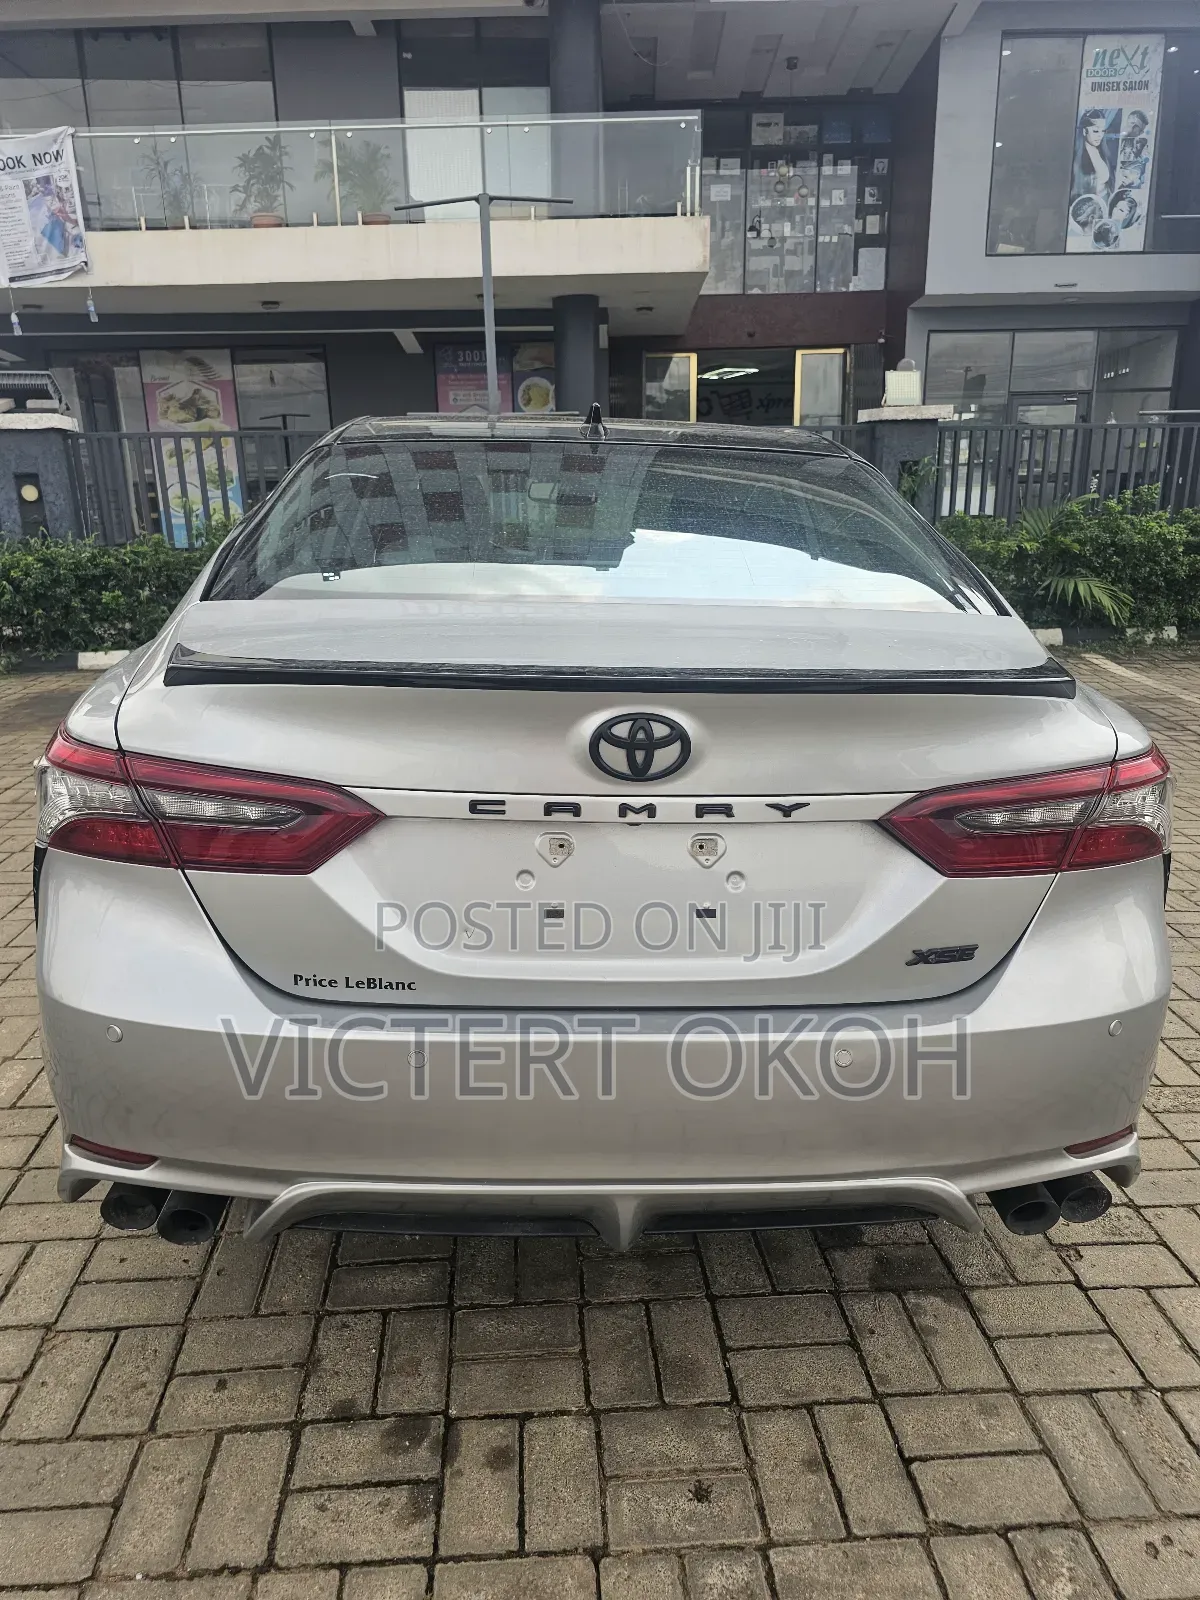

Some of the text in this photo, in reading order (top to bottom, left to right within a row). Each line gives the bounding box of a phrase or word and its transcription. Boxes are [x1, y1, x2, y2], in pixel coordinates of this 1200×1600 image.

[1087, 69, 1116, 77] DOOR
[1091, 80, 1149, 92] UNISEX SALON
[31, 149, 64, 167] NOW
[468, 799, 811, 818] CAMRY
[905, 944, 979, 966] XSE
[293, 974, 417, 991] Price LeBlanc
